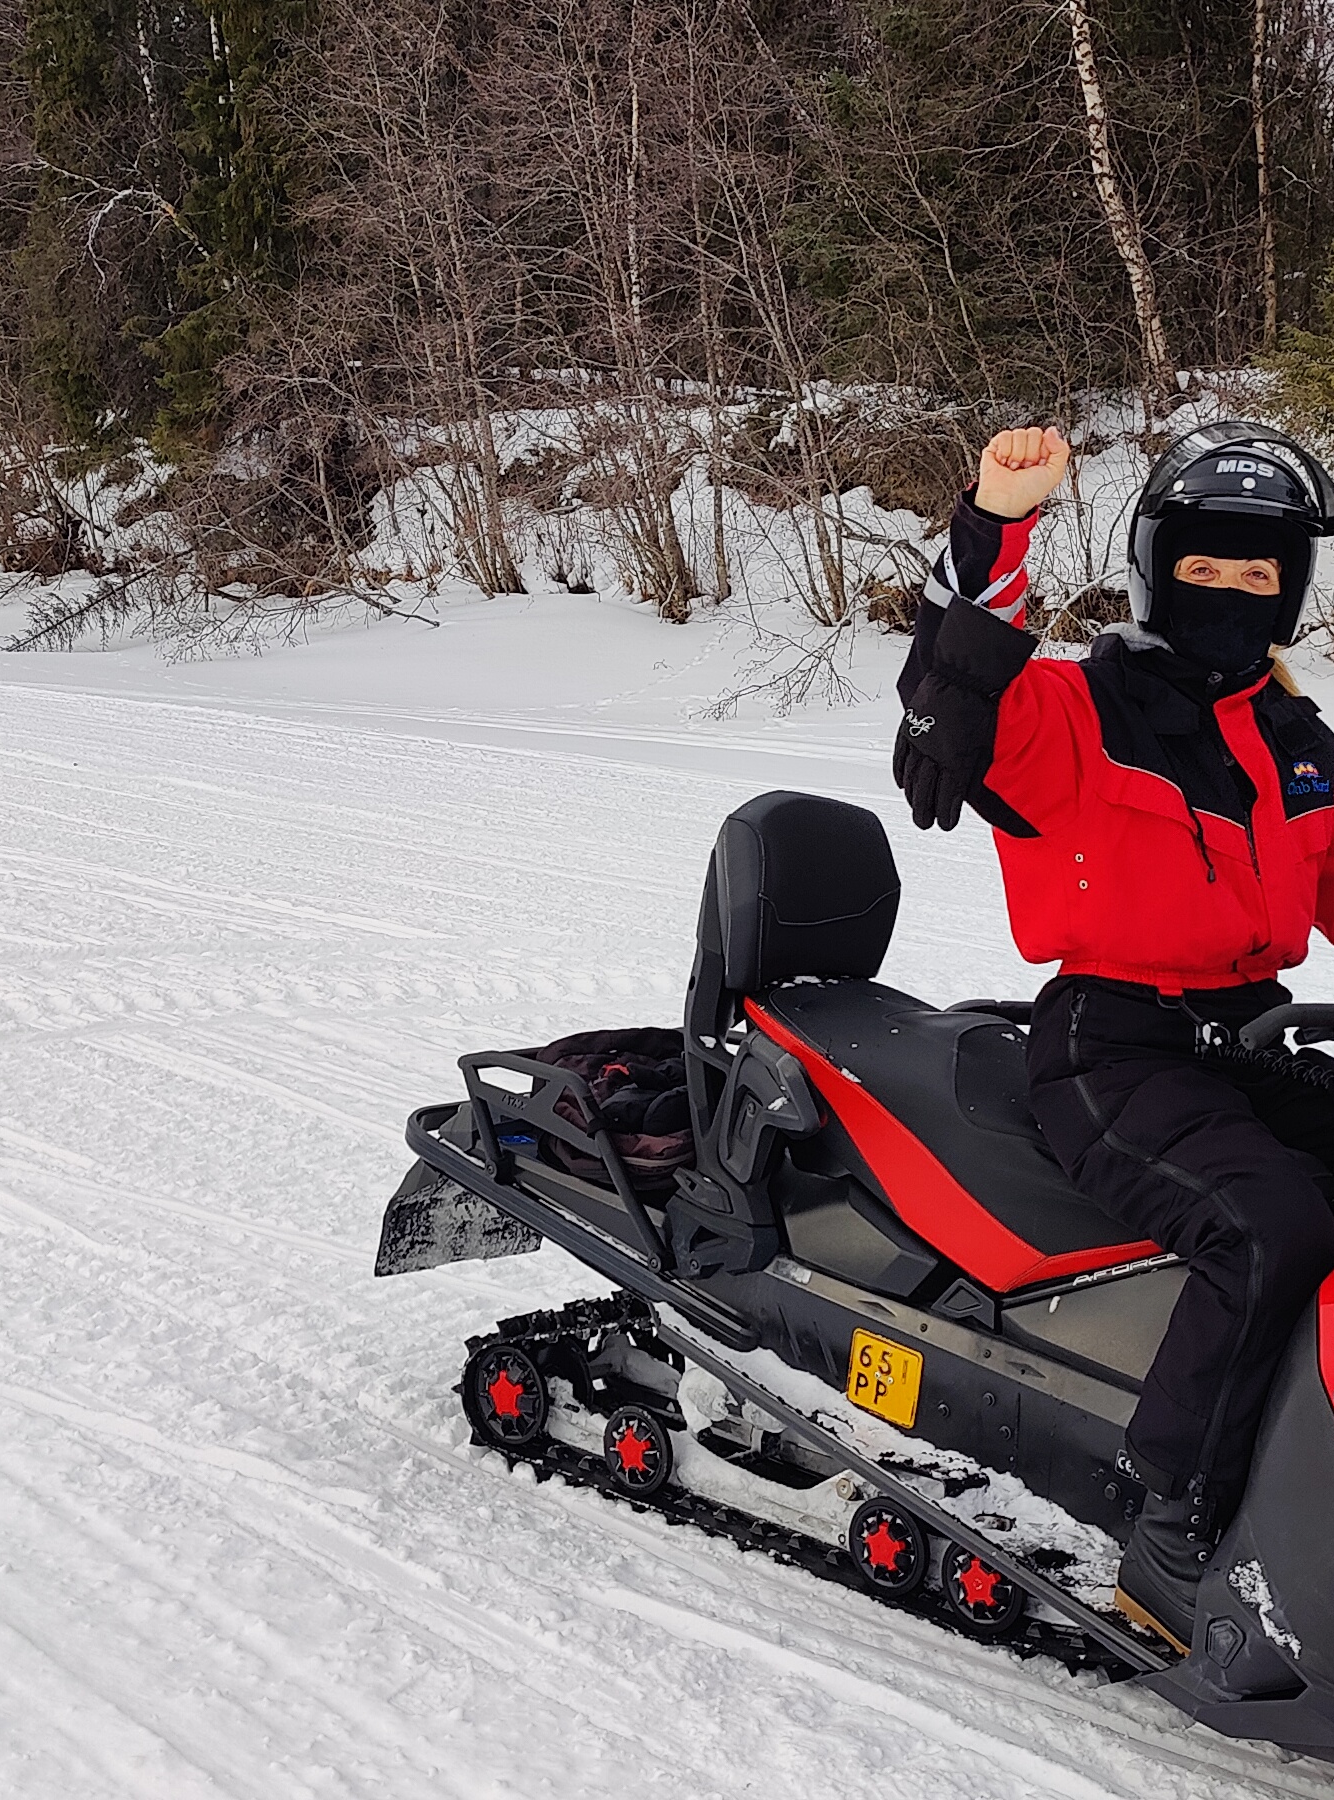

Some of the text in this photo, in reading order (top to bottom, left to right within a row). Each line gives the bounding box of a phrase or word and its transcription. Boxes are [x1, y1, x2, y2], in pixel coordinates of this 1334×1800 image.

[1216, 459, 1275, 478] MDS
[859, 1344, 893, 1376] 65
[854, 1371, 888, 1405] PP
